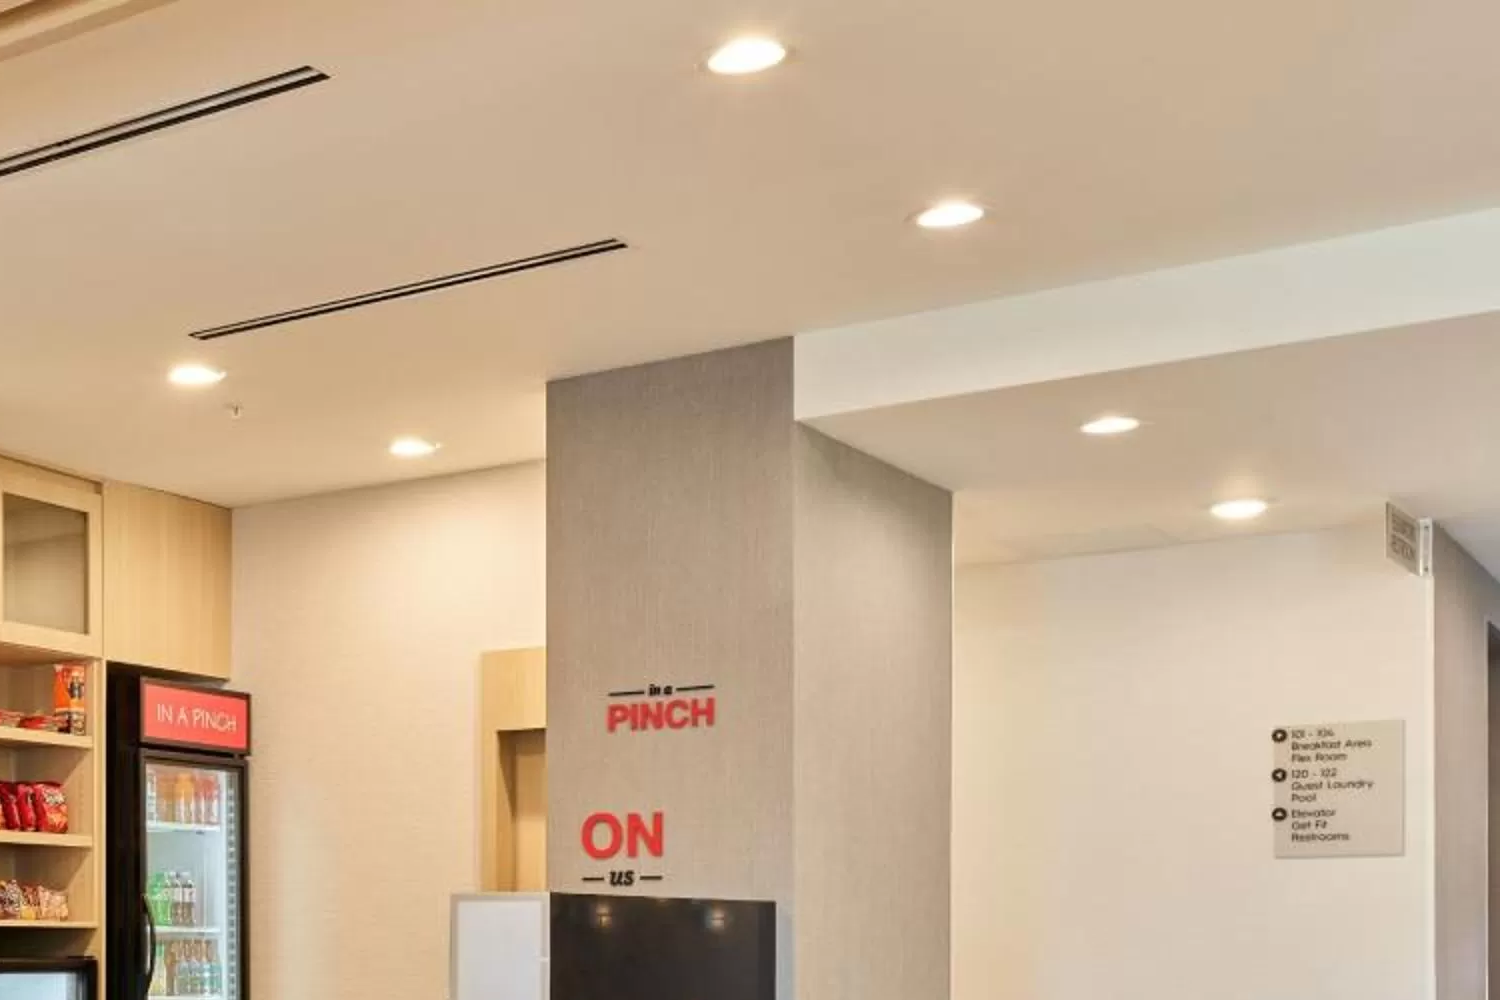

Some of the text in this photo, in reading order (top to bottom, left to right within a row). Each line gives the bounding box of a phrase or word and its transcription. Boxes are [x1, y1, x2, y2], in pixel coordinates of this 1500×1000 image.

[648, 684, 673, 696] in a
[156, 703, 237, 733] IN A PINCH
[606, 697, 716, 733] PINCH
[1291, 739, 1373, 751] Breakfast Area
[1315, 752, 1348, 762] Room
[1291, 779, 1374, 791] Guest Laundry
[1291, 793, 1317, 803] Pool
[1291, 809, 1337, 819] Elevator
[580, 811, 664, 861] ON
[1291, 832, 1350, 843] Restrooms
[609, 869, 635, 887] us
